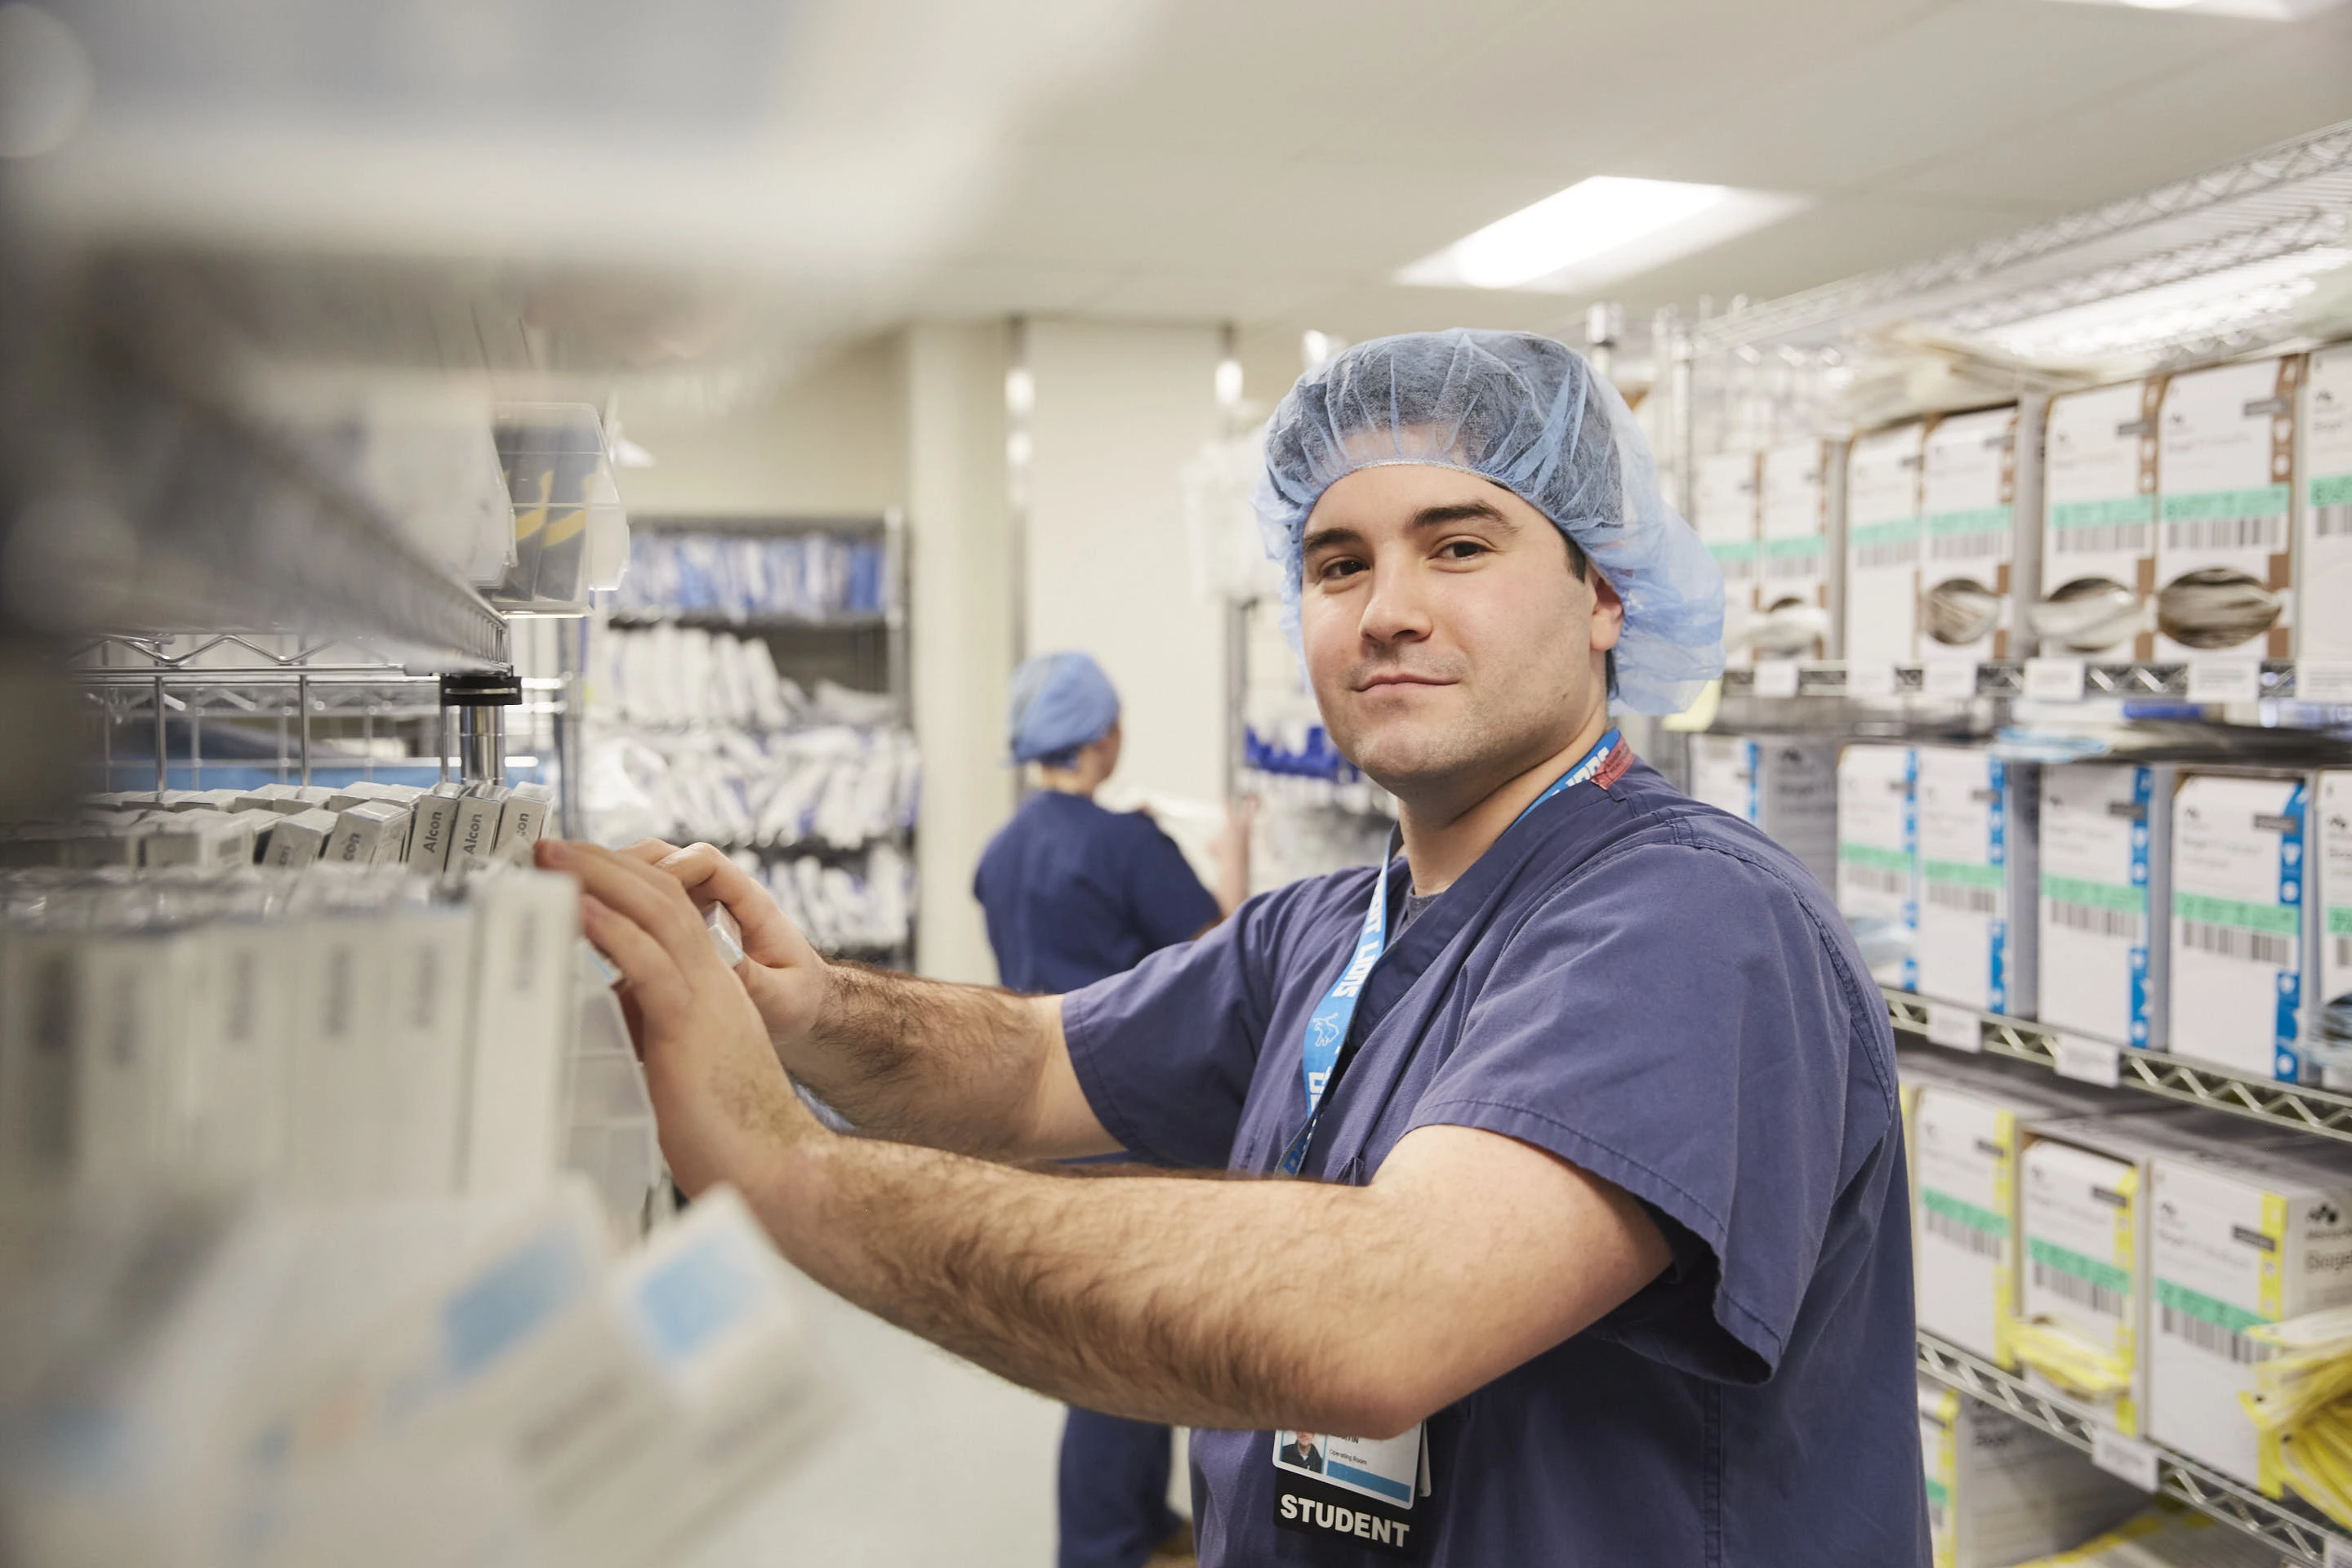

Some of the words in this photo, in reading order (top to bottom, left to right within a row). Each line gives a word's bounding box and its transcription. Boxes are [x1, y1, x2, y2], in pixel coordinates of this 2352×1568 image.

[342, 831, 362, 862] con
[422, 810, 443, 854] Alcon
[462, 813, 483, 856] Alcon
[1330, 940, 1380, 998] LIONS
[1330, 1449, 1352, 1462] Operating
[1352, 1455, 1368, 1465] Room
[1280, 1493, 1410, 1548] STUDENT
